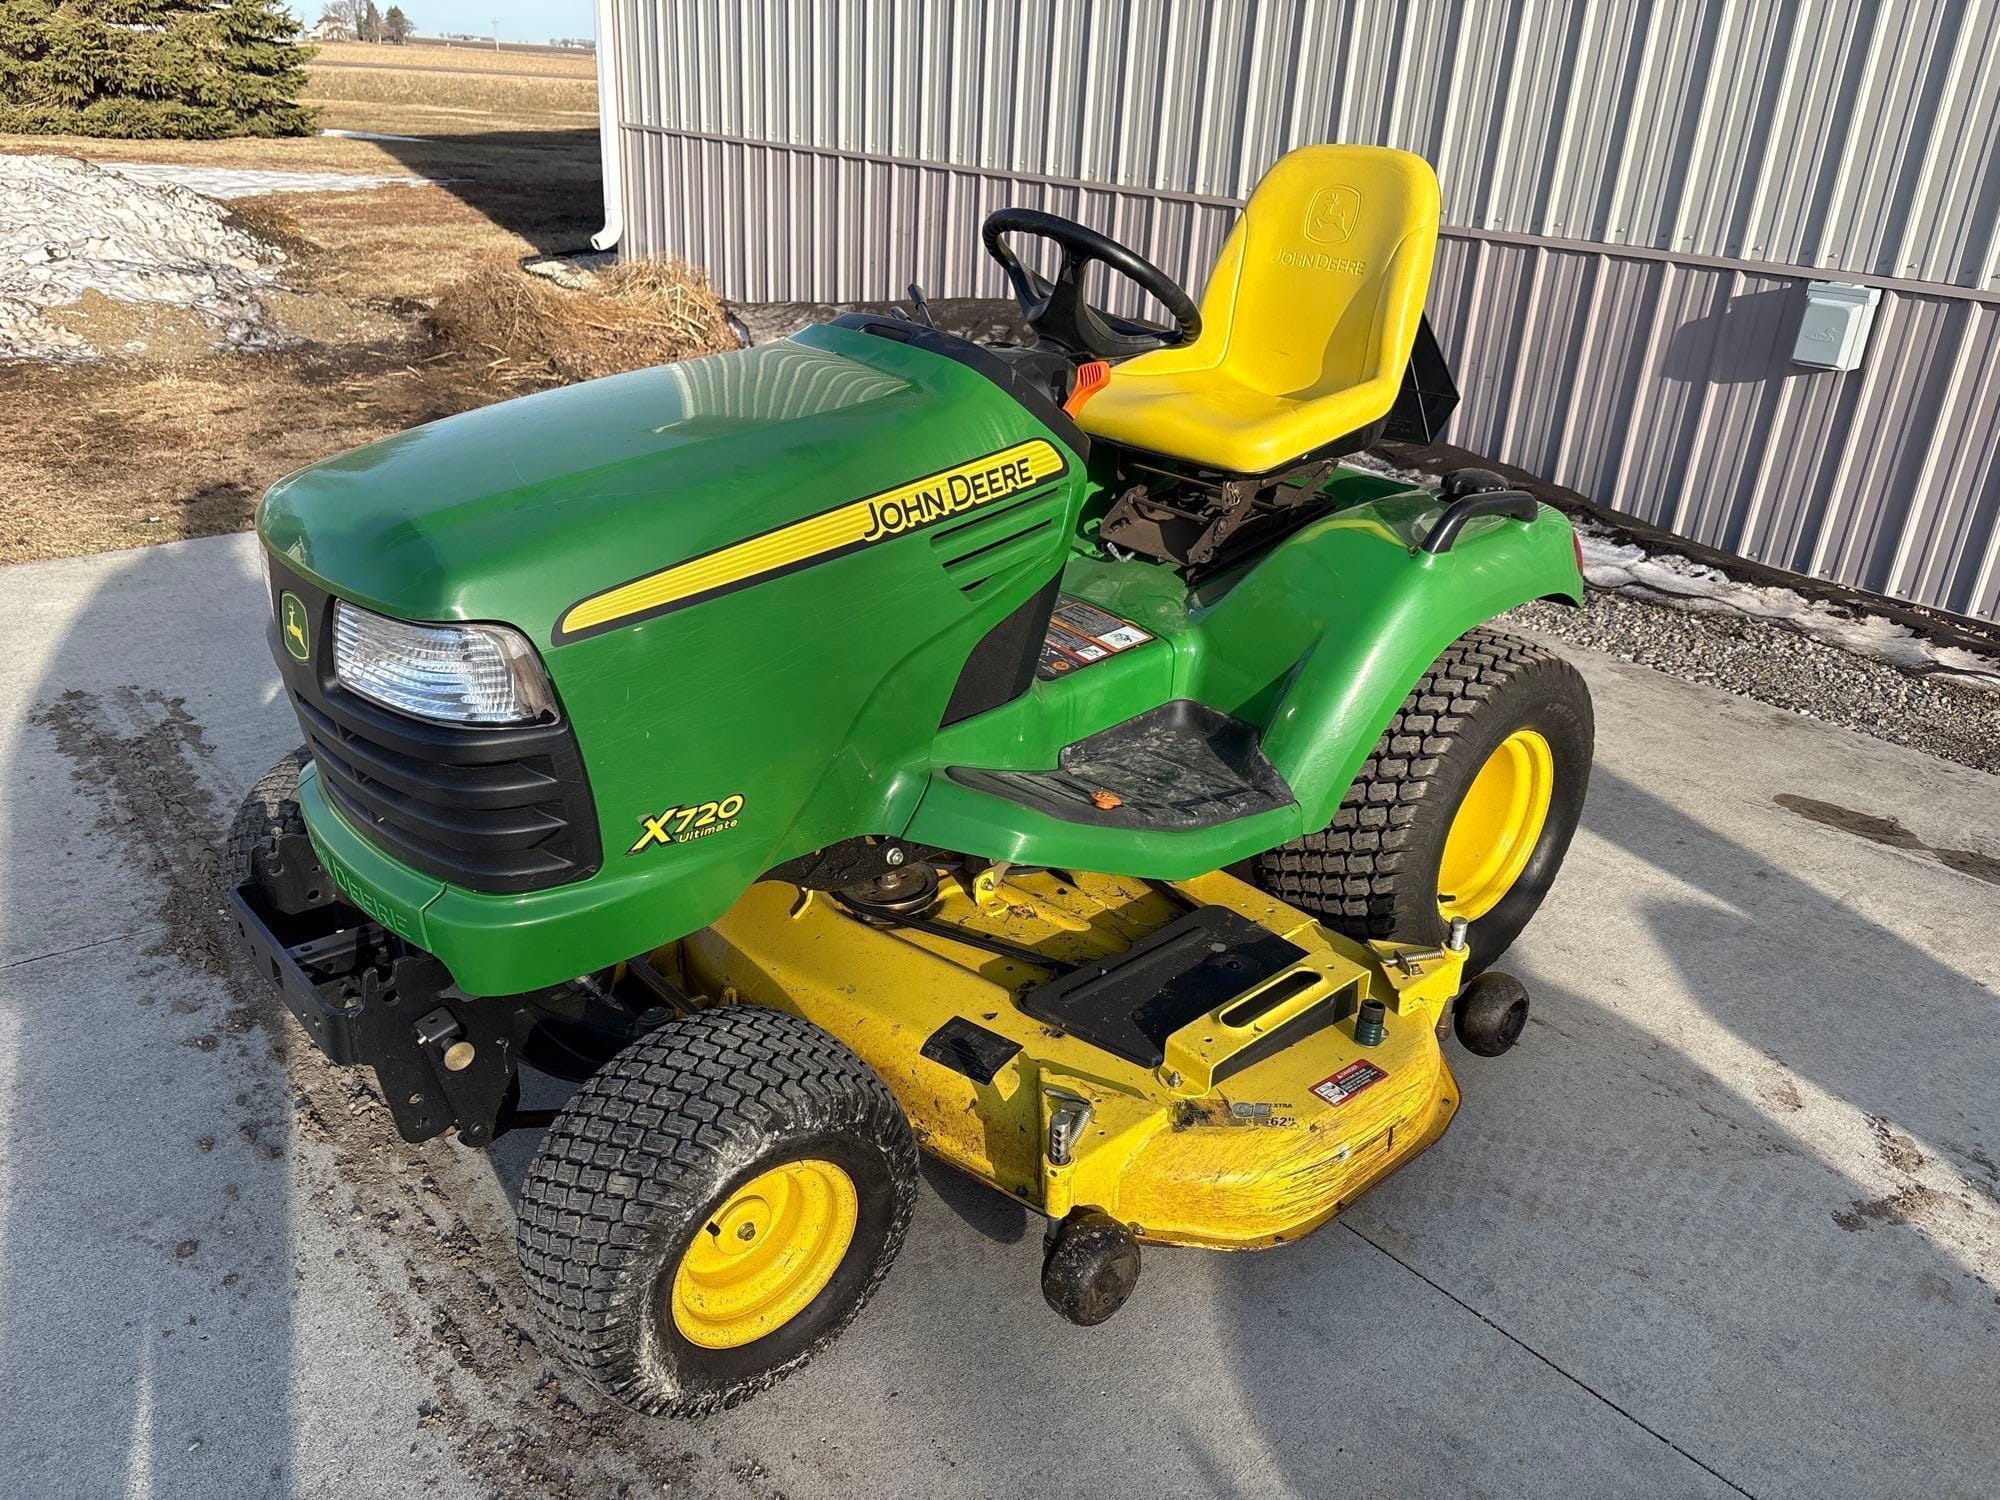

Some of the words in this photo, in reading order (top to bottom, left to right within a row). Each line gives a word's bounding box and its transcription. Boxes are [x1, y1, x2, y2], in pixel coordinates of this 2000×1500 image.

[1270, 248, 1315, 269] JOHN
[1316, 253, 1366, 276] DEERE
[864, 487, 946, 538] JOHN
[947, 457, 1033, 506] DEERE
[627, 794, 745, 855] X720
[678, 818, 738, 844] Ultimate
[332, 859, 411, 938] DEERE
